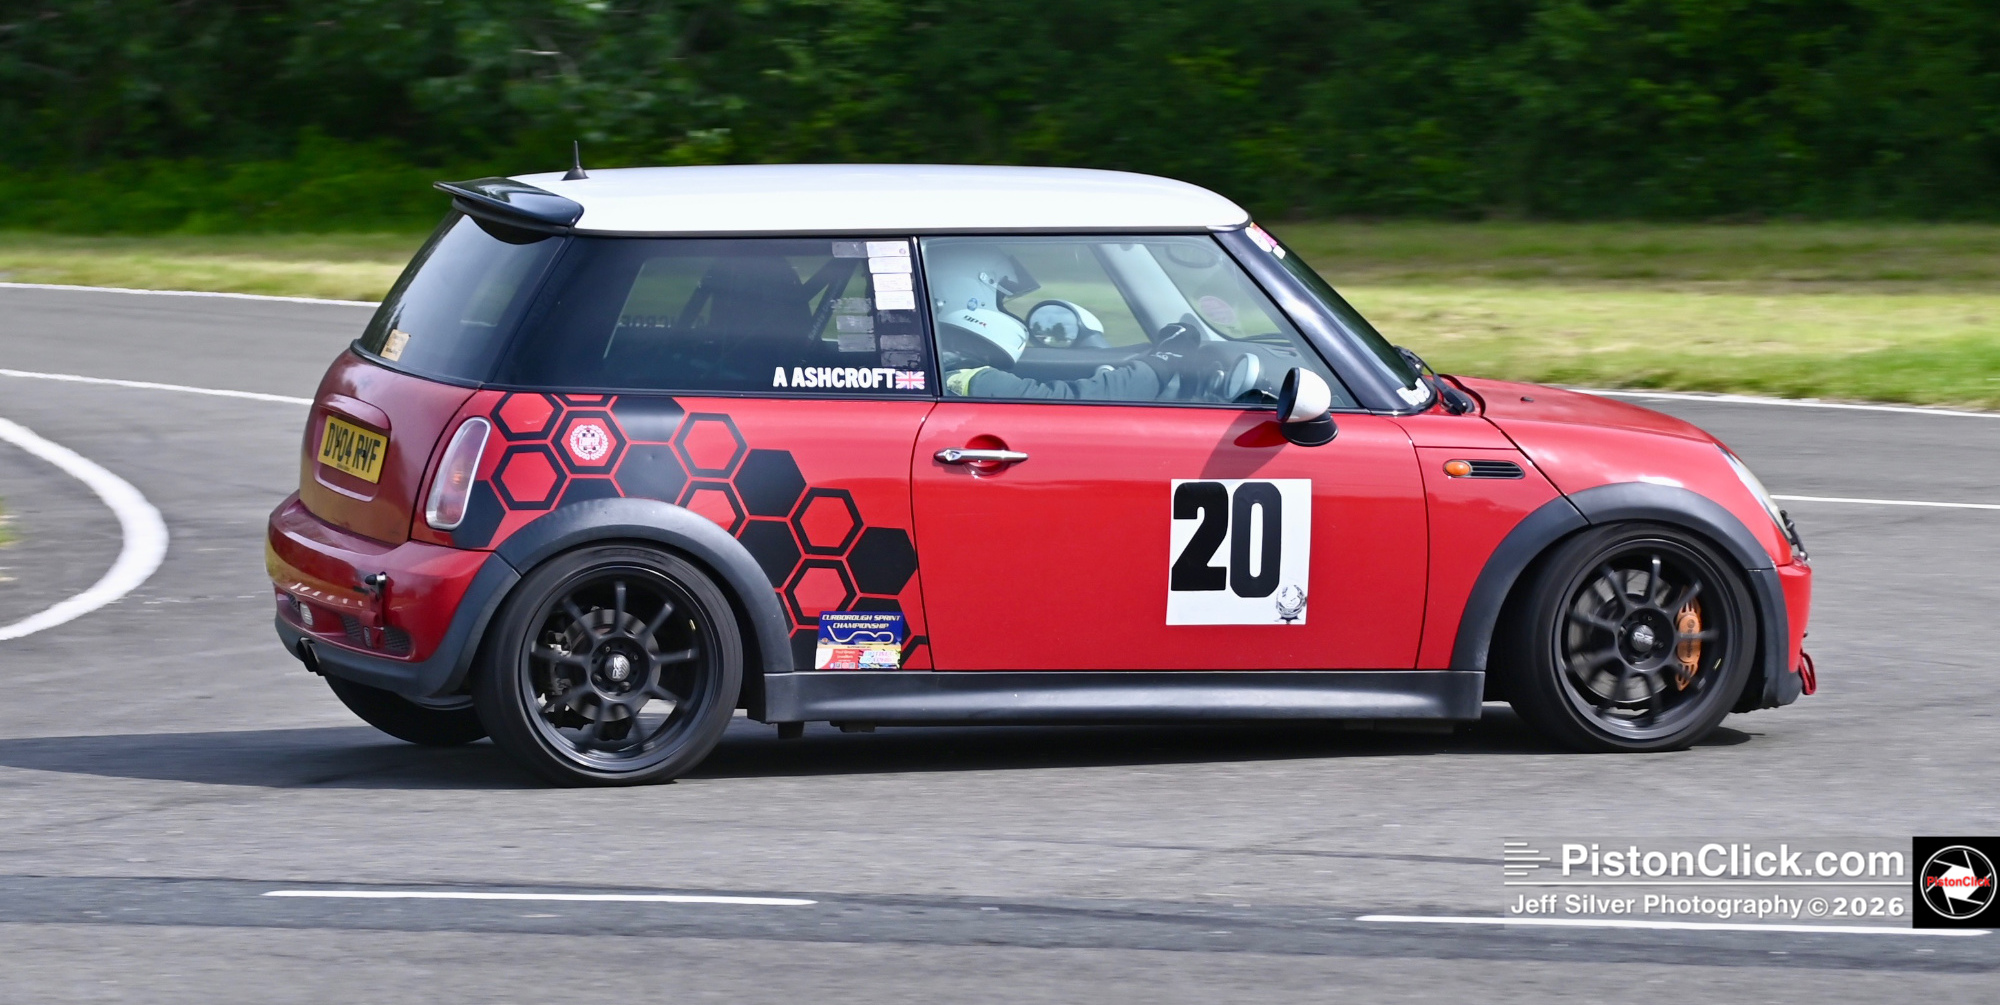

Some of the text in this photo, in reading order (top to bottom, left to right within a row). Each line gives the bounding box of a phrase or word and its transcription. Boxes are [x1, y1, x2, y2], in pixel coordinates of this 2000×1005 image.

[773, 367, 897, 389] A ASHCROFT
[324, 423, 381, 473] DY04 RVF
[1171, 481, 1282, 598] 20
